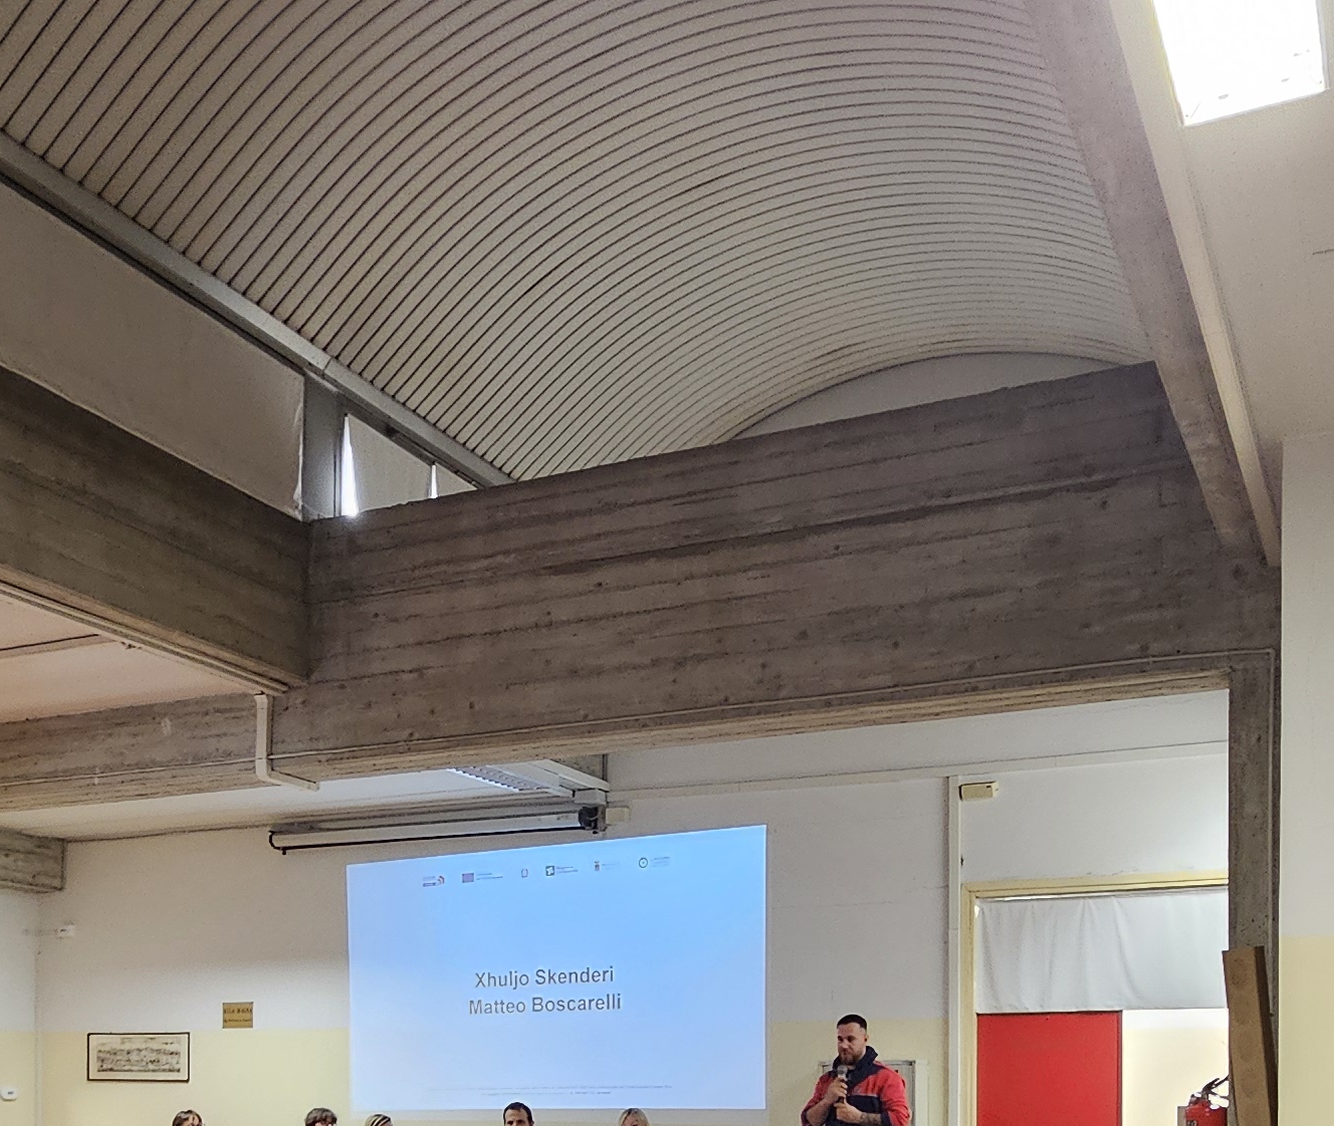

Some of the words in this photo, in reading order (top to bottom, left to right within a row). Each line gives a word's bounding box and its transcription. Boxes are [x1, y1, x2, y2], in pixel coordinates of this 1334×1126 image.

[475, 971, 529, 990] Xhuljo
[535, 966, 614, 985] Skenderi
[469, 999, 526, 1015] Matteo
[532, 993, 621, 1012] Boscarelli
